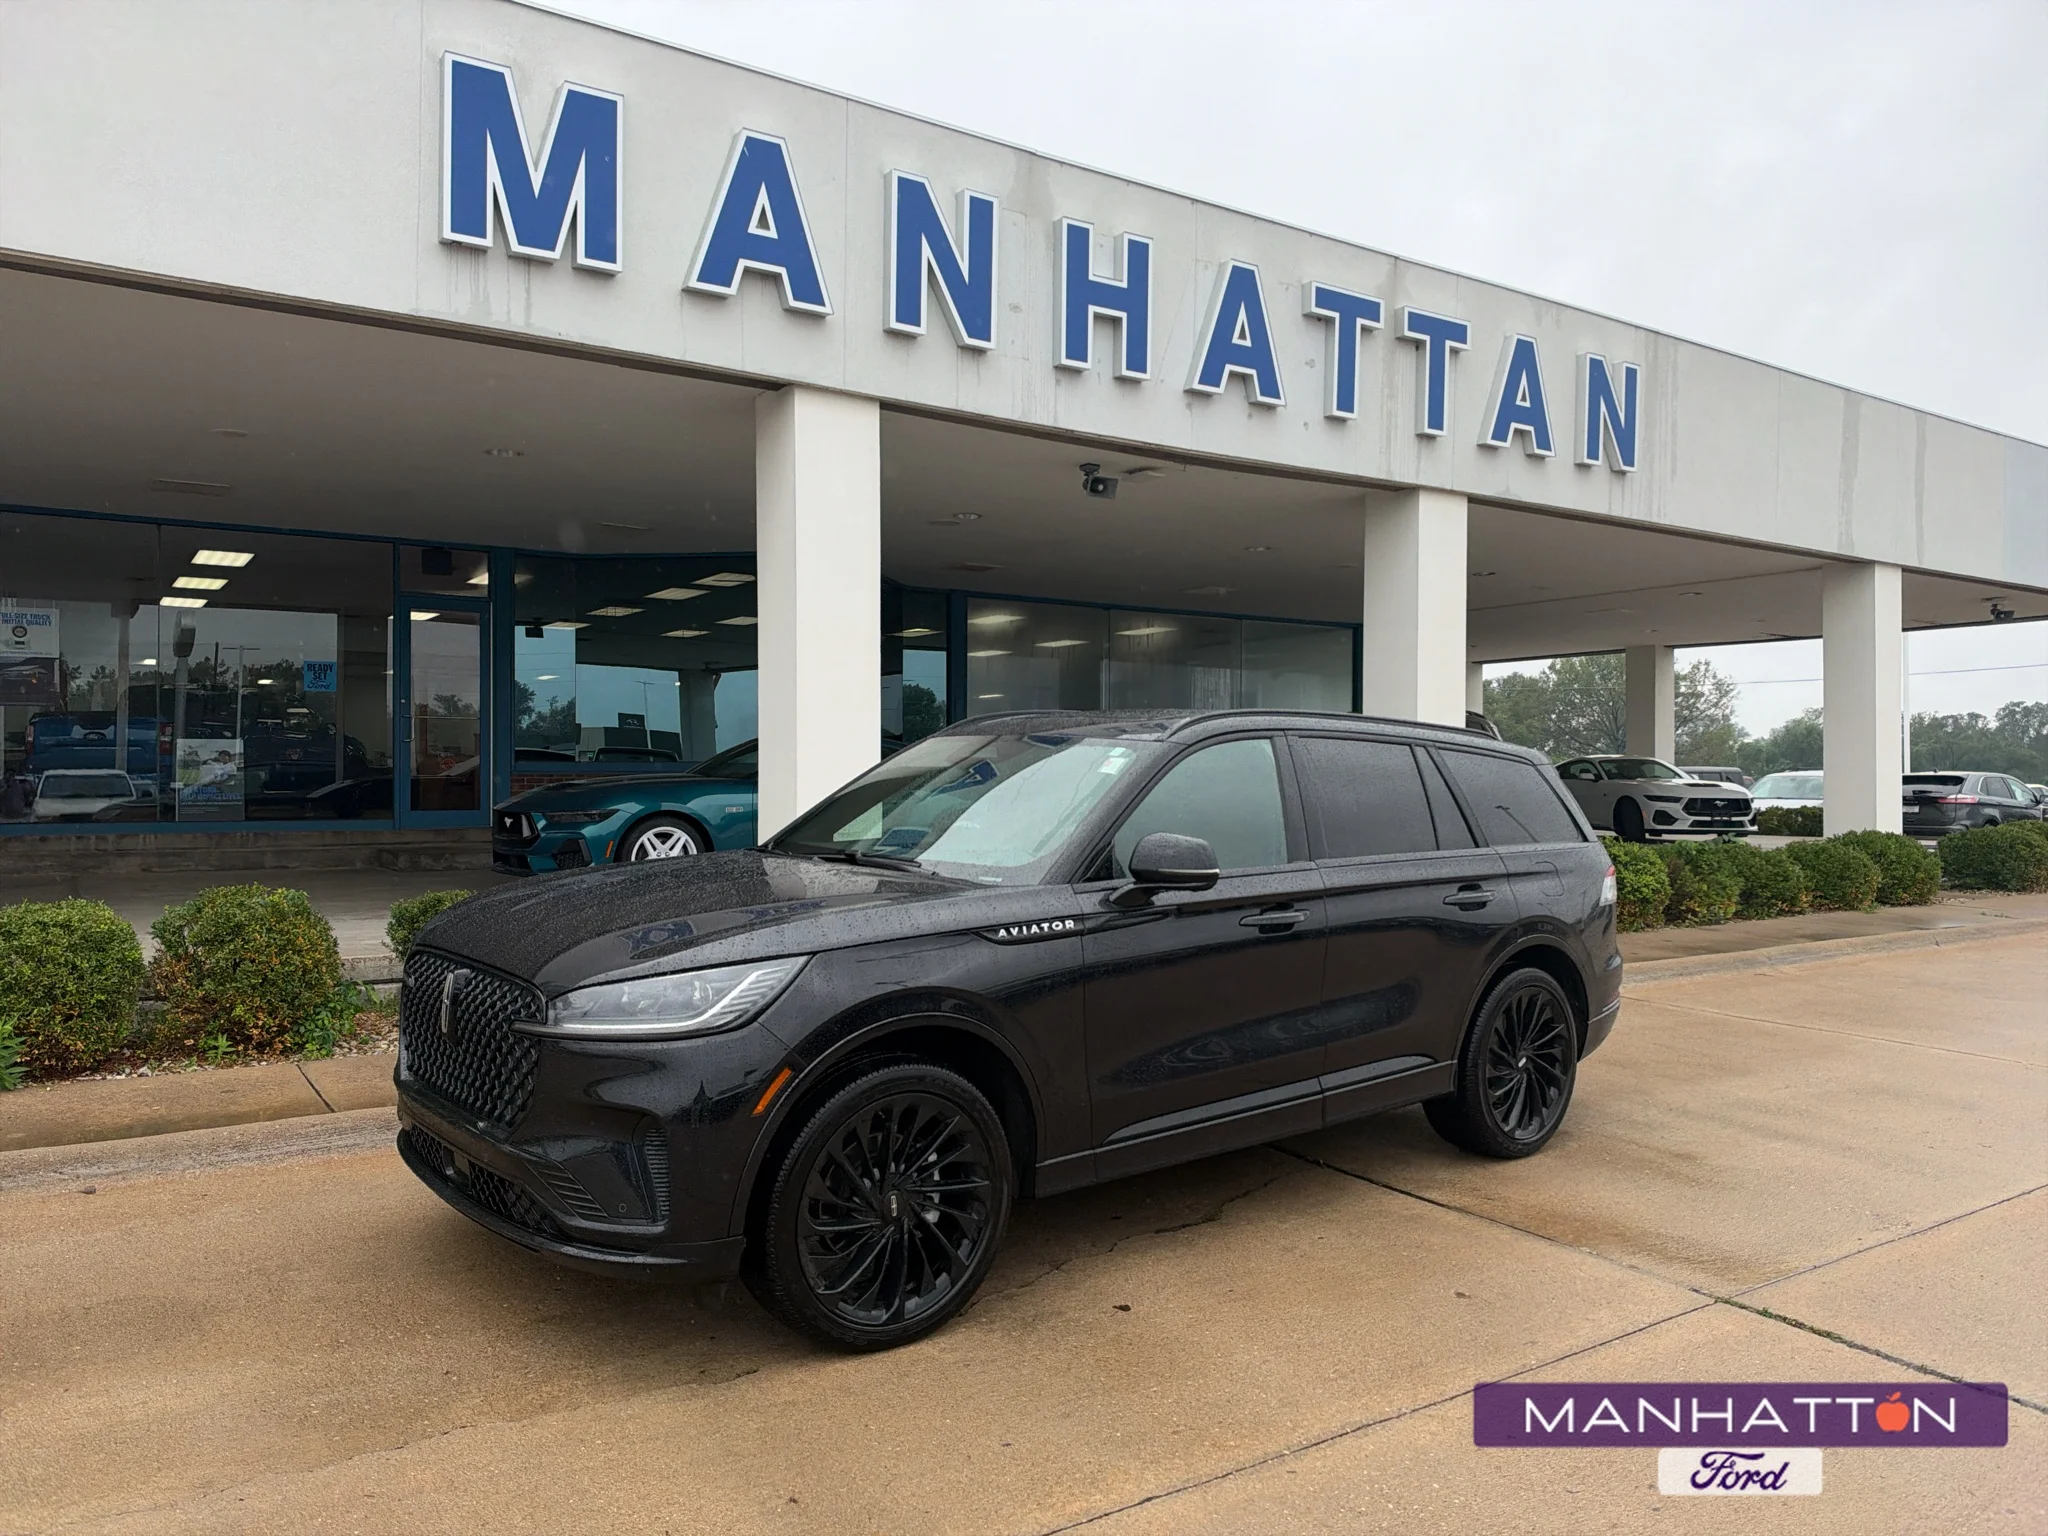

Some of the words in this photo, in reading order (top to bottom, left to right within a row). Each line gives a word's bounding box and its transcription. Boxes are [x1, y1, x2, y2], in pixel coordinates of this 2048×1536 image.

[439, 50, 1641, 474] MANHATTAN
[307, 663, 334, 672] READY
[312, 671, 328, 680] SET
[307, 680, 332, 690] Ford
[998, 920, 1075, 938] AVIATOR
